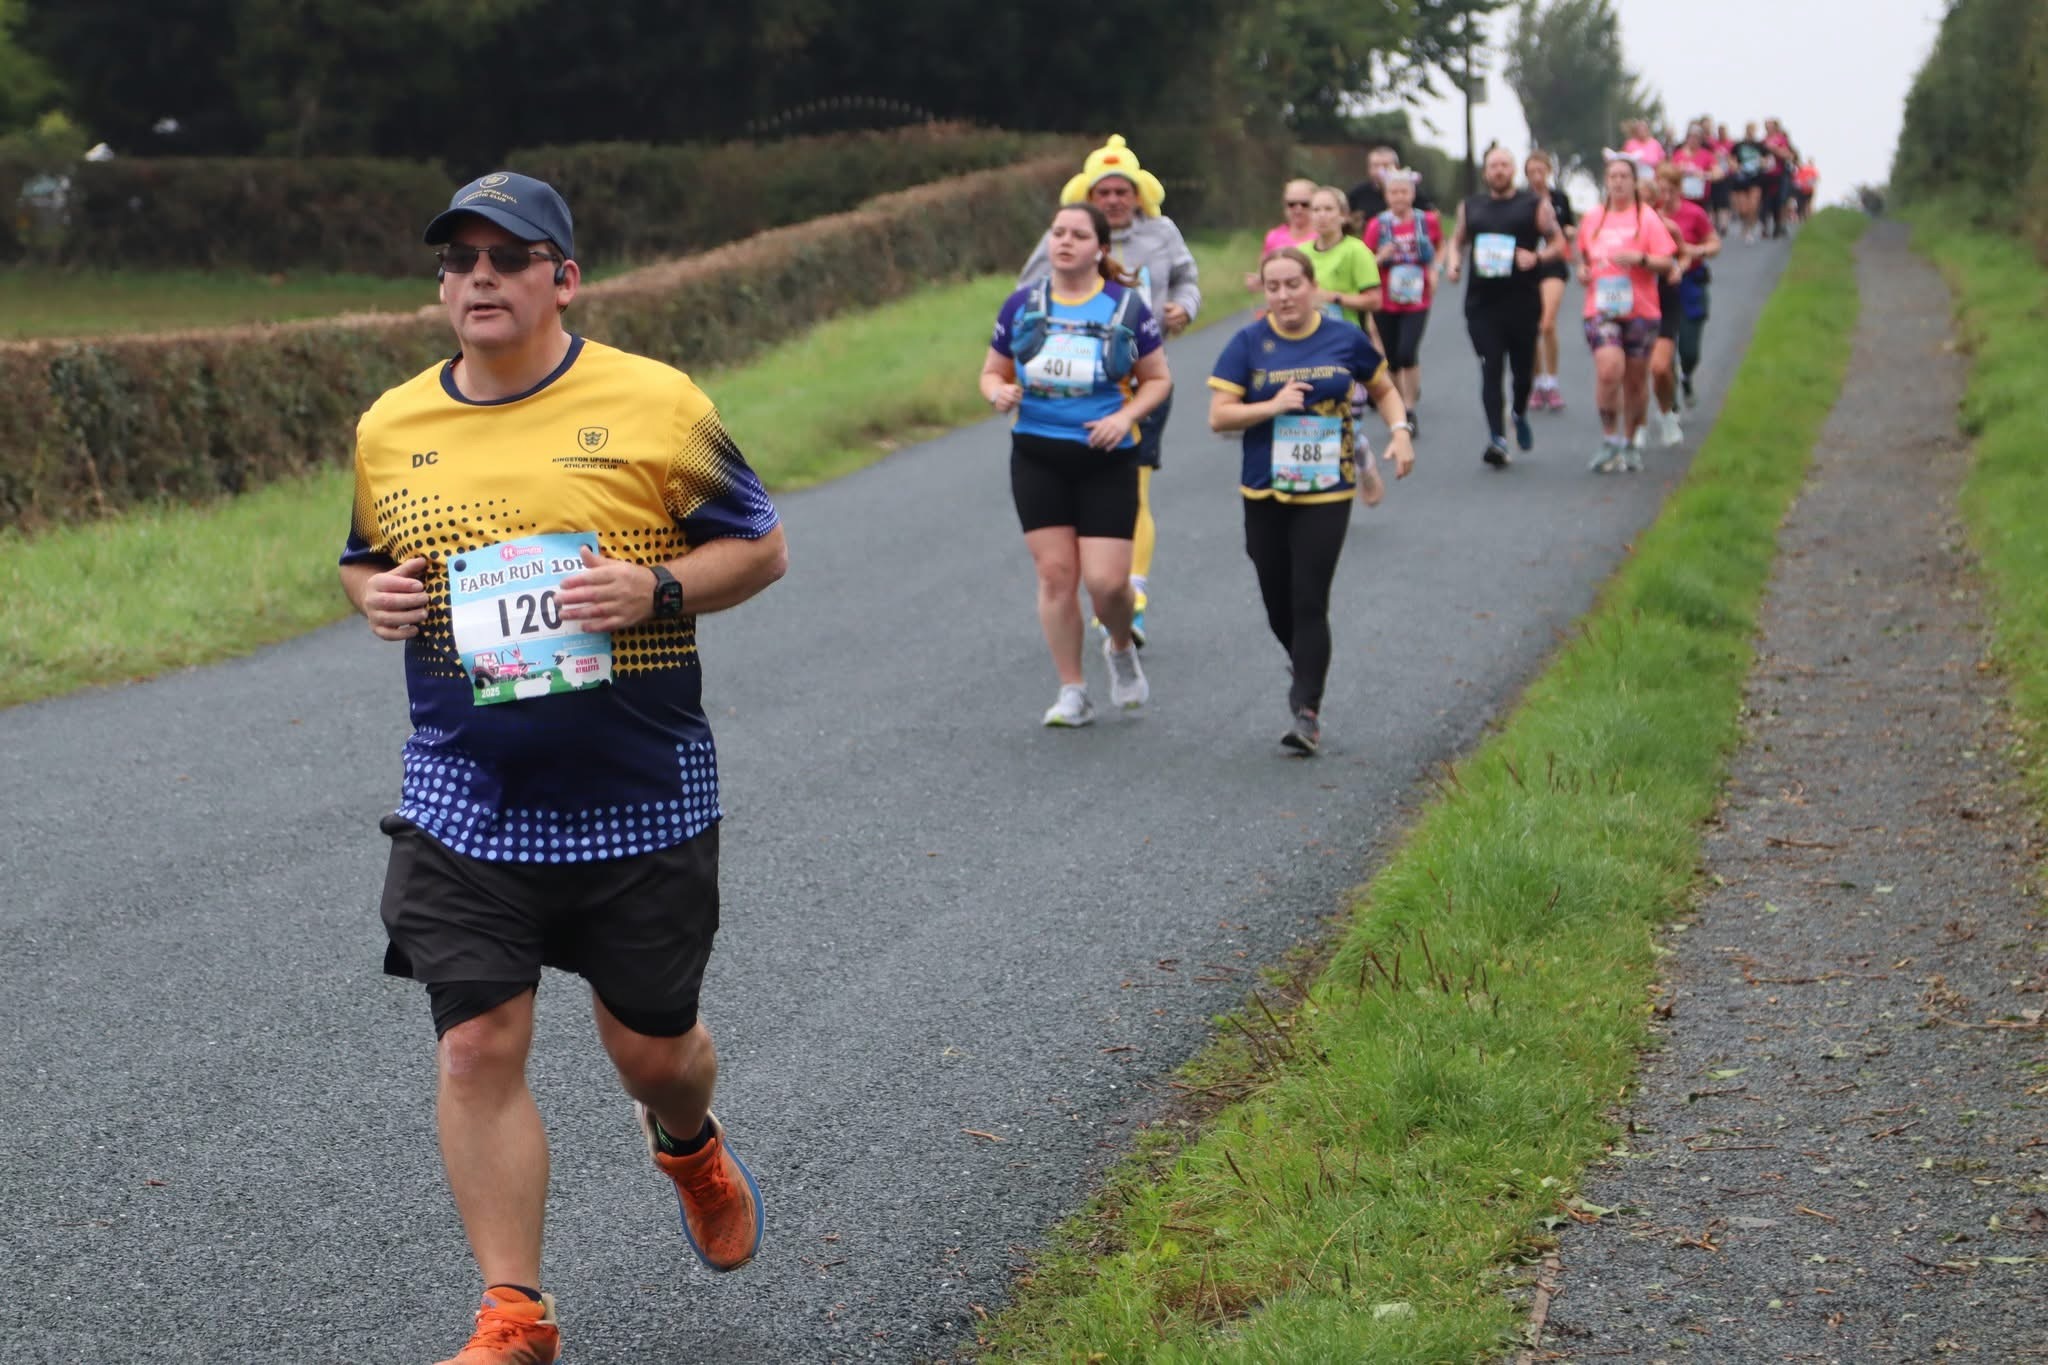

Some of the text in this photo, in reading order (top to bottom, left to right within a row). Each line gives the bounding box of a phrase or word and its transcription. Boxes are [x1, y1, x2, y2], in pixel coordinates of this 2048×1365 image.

[1043, 358, 1072, 377] 401
[412, 451, 439, 469] DC
[1292, 444, 1322, 462] 488
[460, 571, 504, 592] FARM
[509, 560, 544, 580] RUN
[498, 590, 562, 637] 120
[481, 687, 501, 699] 2025
